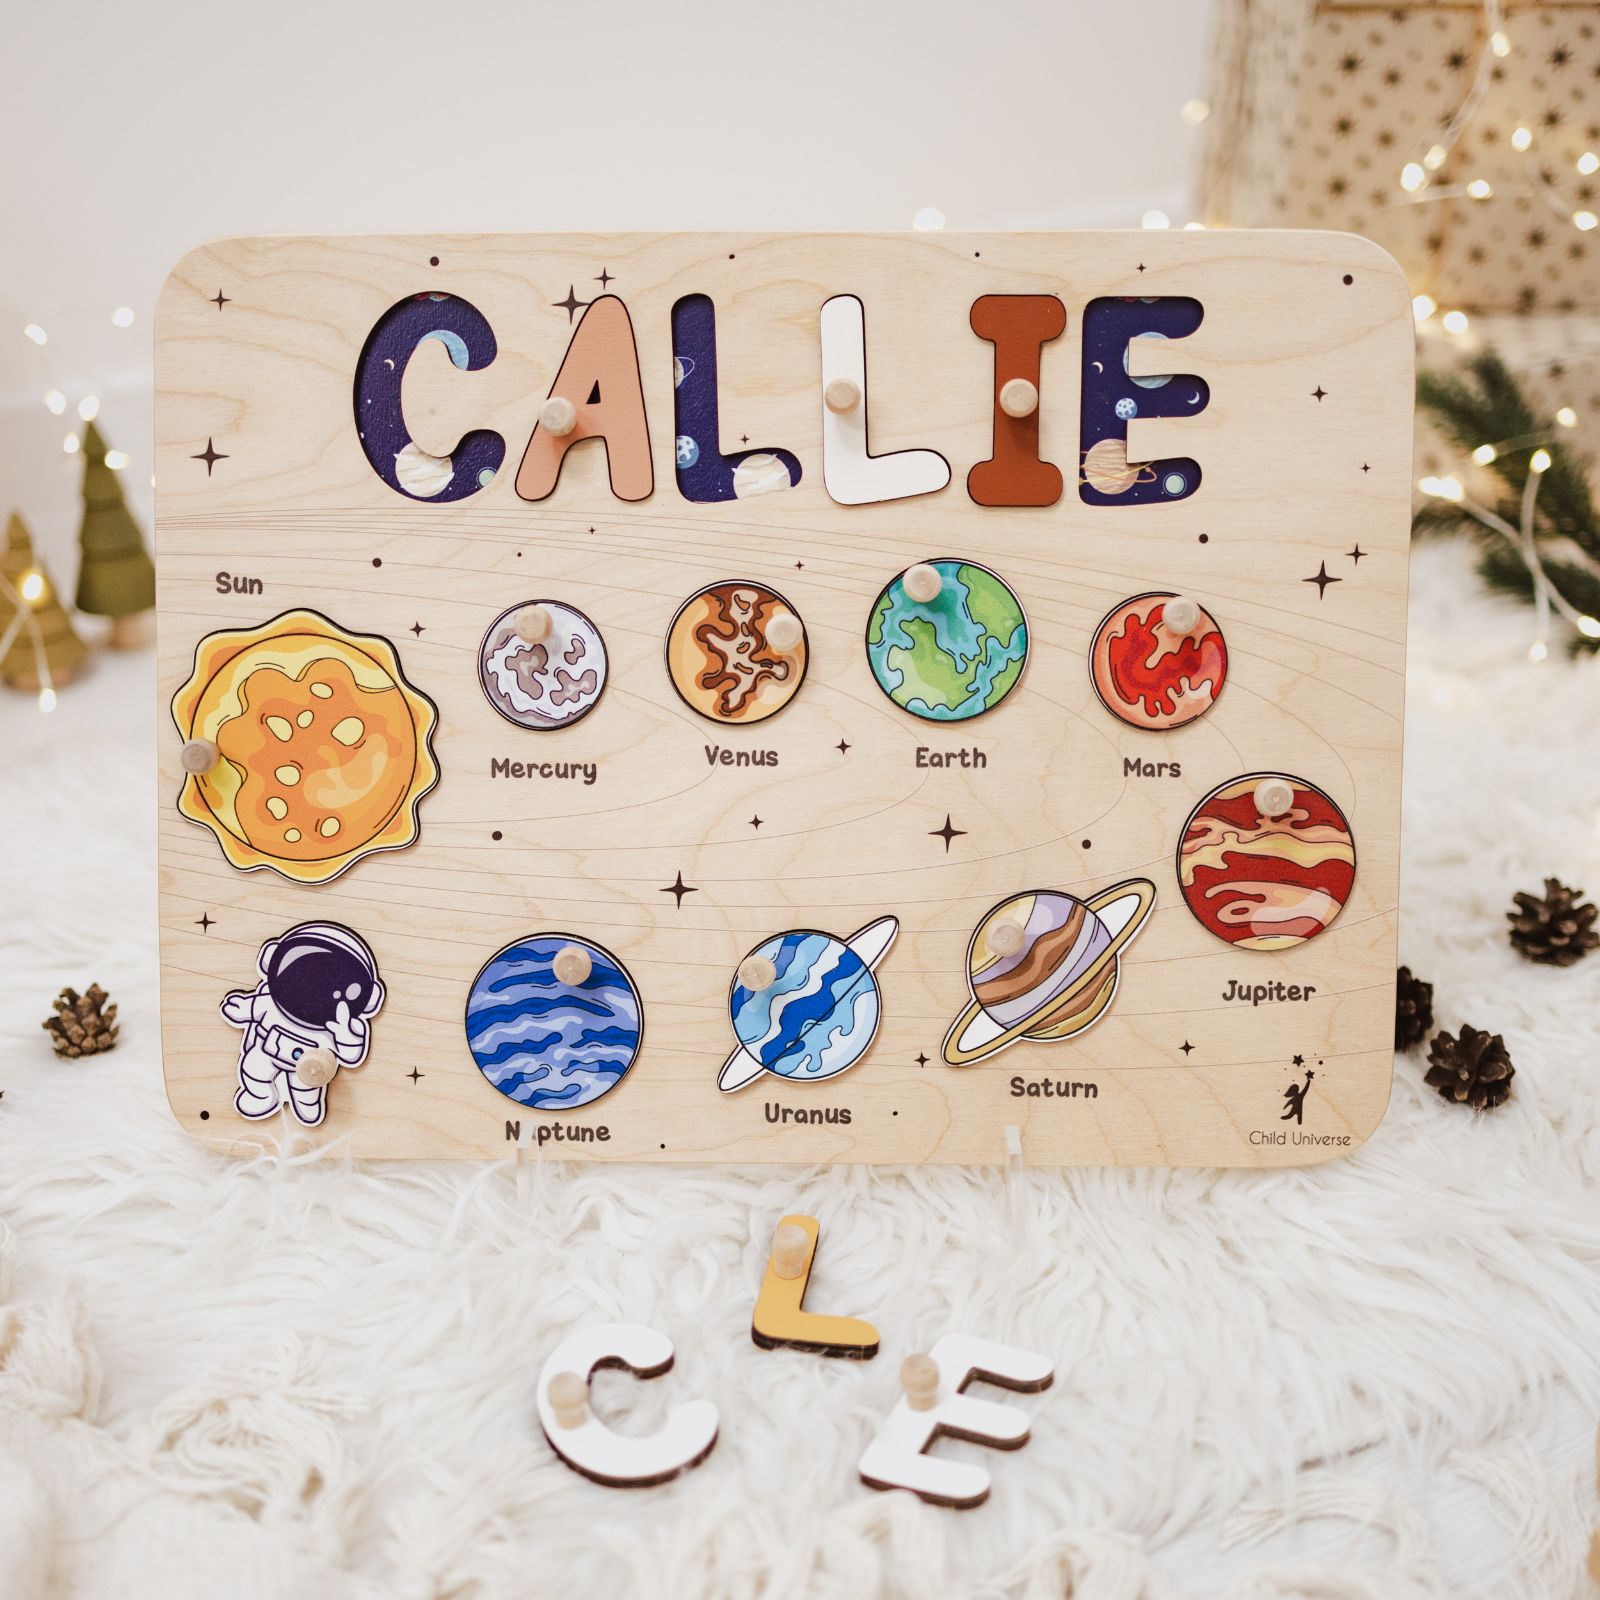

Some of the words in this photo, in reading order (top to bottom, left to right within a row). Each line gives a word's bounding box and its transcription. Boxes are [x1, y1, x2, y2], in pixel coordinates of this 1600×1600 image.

[354, 290, 1211, 507] CALLIE
[215, 571, 264, 595] Sun
[704, 745, 779, 768] Venus
[915, 746, 988, 769] Earth
[1123, 757, 1182, 778] Mars
[491, 757, 597, 786] Mercury
[1222, 979, 1317, 1007] Jupiter
[1010, 1076, 1099, 1099] Saturn
[764, 1102, 852, 1125] Uranus
[505, 1120, 611, 1147] Nptune
[1249, 1130, 1287, 1146] Child
[1291, 1131, 1351, 1147] Universe
[752, 1215, 880, 1361] L
[537, 1323, 719, 1488] C
[858, 1334, 1054, 1510] E
